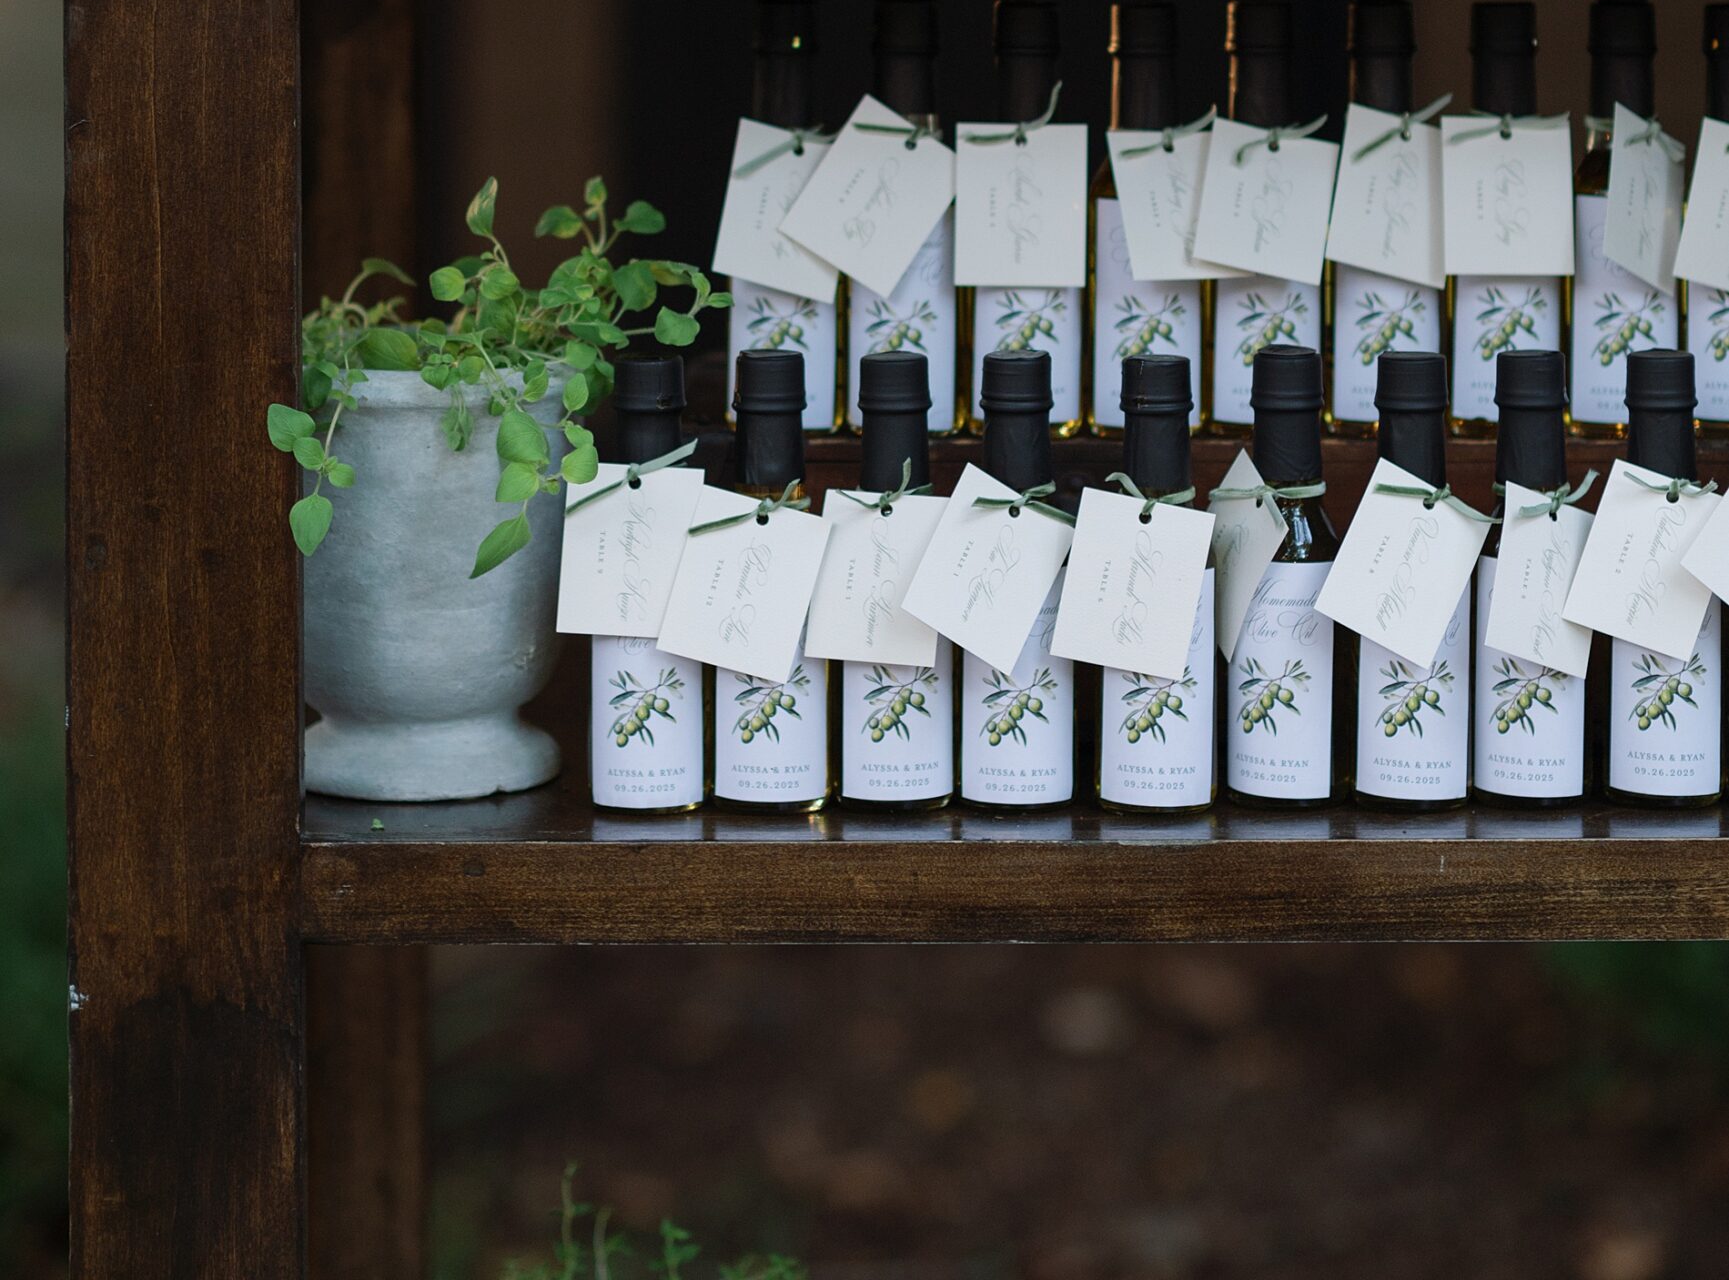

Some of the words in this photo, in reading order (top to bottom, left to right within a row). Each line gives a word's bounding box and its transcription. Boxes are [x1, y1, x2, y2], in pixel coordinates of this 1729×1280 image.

[598, 531, 607, 564] TABLE
[957, 540, 975, 569] TABLE
[1373, 535, 1391, 565] TABLE
[1618, 533, 1635, 566] TABLE
[710, 559, 725, 591] TABLE
[846, 559, 856, 591] TABLE
[1099, 560, 1112, 593] TABLE
[1522, 558, 1532, 590] TABLE
[1235, 752, 1267, 766] ALYSSA
[1280, 759, 1310, 768] RYAN
[1372, 756, 1411, 769] ALYSSA
[1425, 760, 1452, 770] RYAN
[1487, 753, 1524, 766] ALYSSA
[1538, 759, 1566, 769] RYAN
[1626, 750, 1665, 762] ALYSSA
[1679, 752, 1706, 763] RYAN
[607, 768, 645, 778] ALYSSA
[659, 766, 686, 777] RYAN
[731, 764, 769, 775] ALYSSA
[783, 764, 811, 775] RYAN
[860, 763, 900, 773] ALYSSA
[913, 760, 939, 772] RYAN
[978, 767, 1016, 777] ALYSSA
[1030, 767, 1057, 778] RYAN
[1116, 763, 1155, 775] ALYSSA
[1168, 765, 1197, 776] RYAN
[1634, 766, 1696, 777] 09.26.2025
[868, 777, 930, 788] 09.26.2025
[1239, 769, 1298, 784] 09.26.2025
[1379, 772, 1441, 785] 09.26.2025
[1493, 769, 1555, 783] 09.26.2025
[613, 783, 677, 793] 09.26.2025
[737, 779, 800, 790] 09.26.2025
[984, 782, 1047, 793] 09.26.2025
[1123, 779, 1185, 793] 09.26.2025
